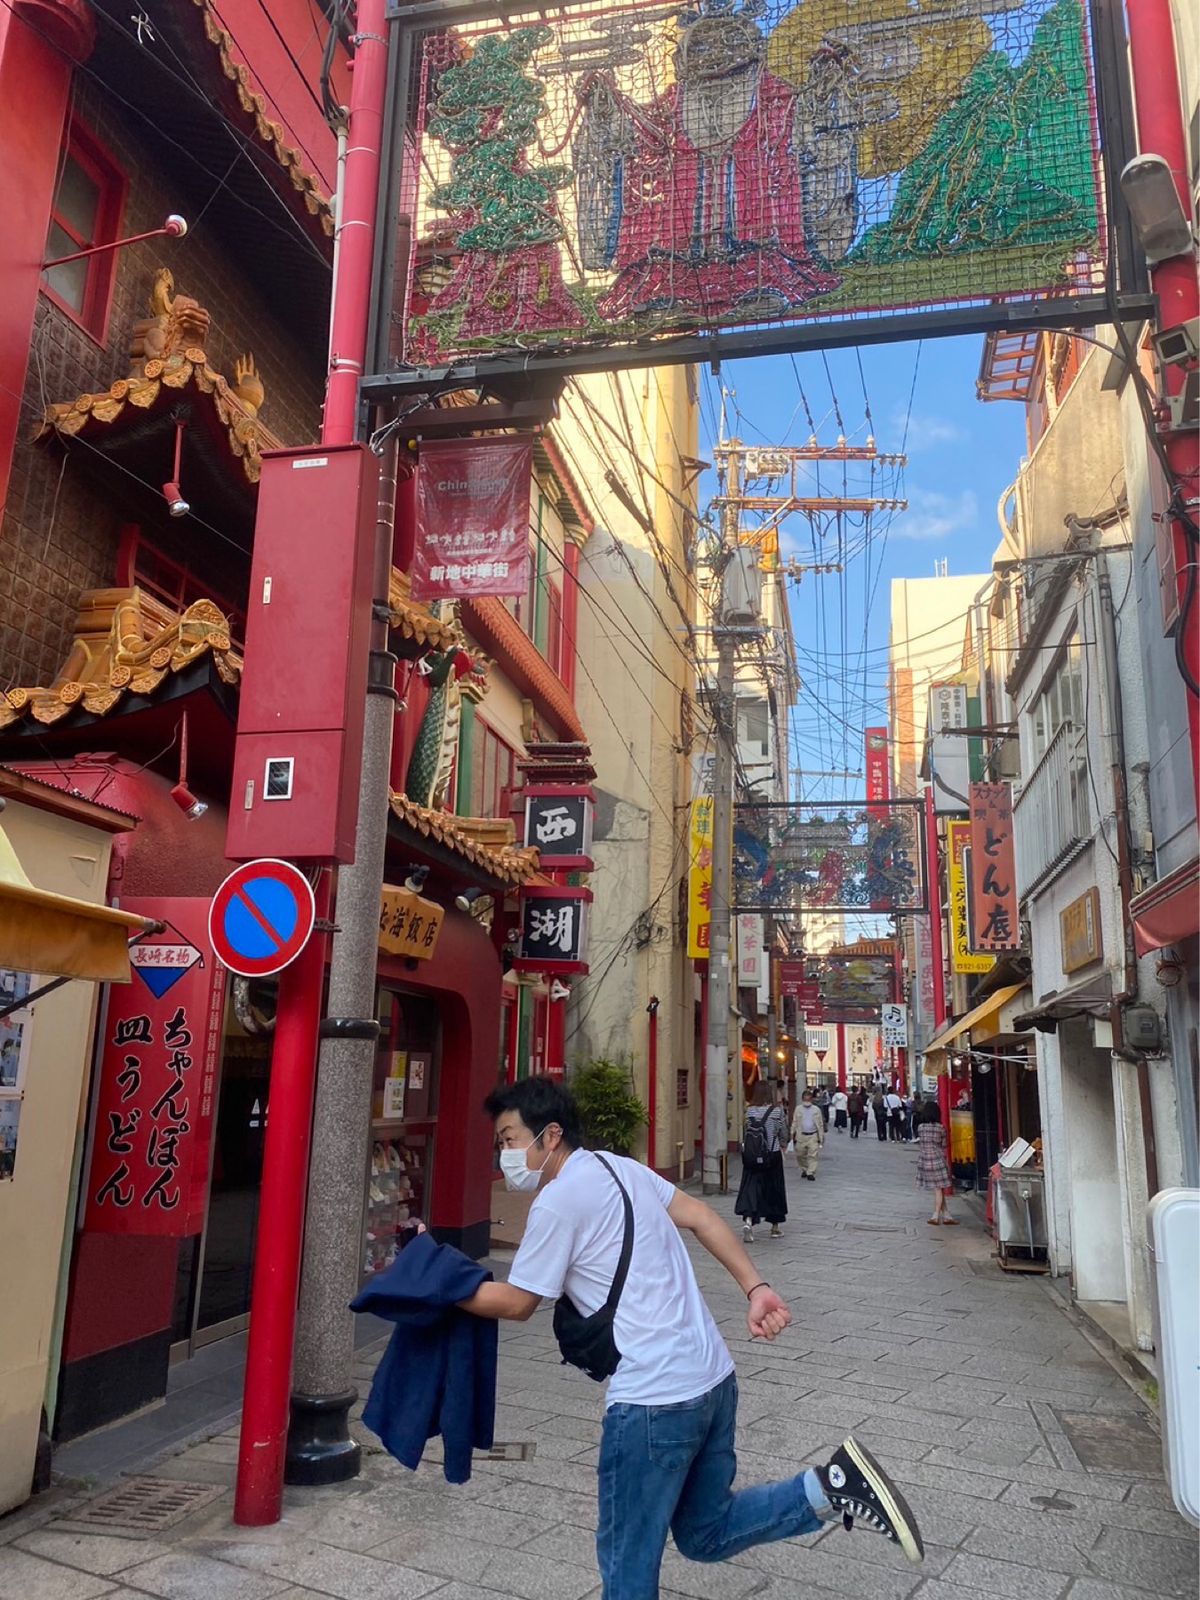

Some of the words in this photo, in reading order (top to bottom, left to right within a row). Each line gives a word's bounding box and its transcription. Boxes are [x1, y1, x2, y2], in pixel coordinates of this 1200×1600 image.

[981, 827, 1012, 942] どん底
[135, 948, 190, 964] 長崎名物
[142, 1006, 193, 1209] ちゃんぽん
